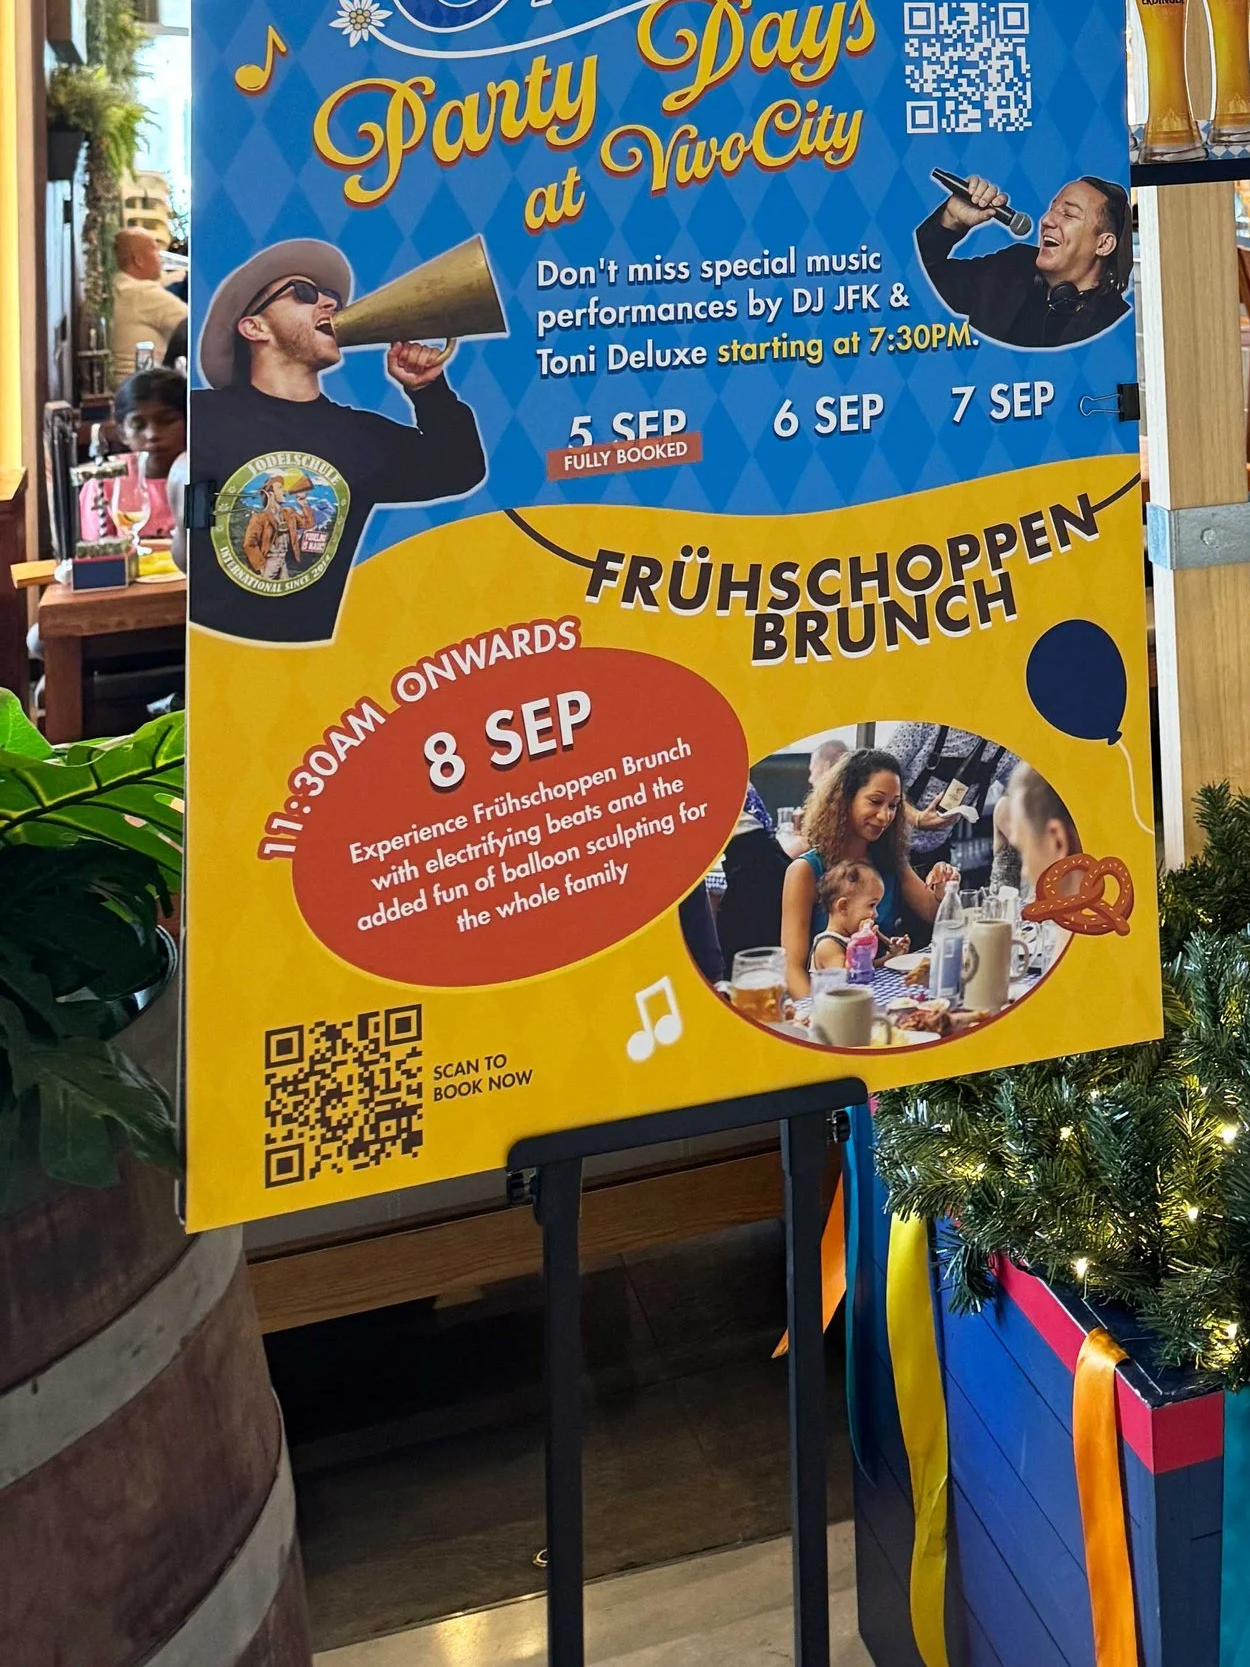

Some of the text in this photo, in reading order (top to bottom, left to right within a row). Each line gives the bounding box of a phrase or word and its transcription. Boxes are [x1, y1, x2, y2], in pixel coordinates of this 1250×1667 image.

[313, 53, 599, 207] Party
[524, 98, 863, 231] at VivoCity
[537, 245, 881, 287] Don't miss special music
[537, 283, 910, 337] performances by DJ JFK &
[536, 322, 979, 375] Toni Deluxe starting at 7:30PM.
[568, 407, 687, 450] 5 SEP
[773, 393, 884, 438] 6 SEP
[951, 381, 1055, 423] 7 SEP
[564, 441, 688, 471] FULLY BOOKED
[220, 545, 283, 593] INTERNATIONAL
[285, 577, 309, 592] SINCE
[585, 492, 1099, 617] FRÜHSCHOPPEN
[751, 572, 1017, 666] BRUNCH
[263, 620, 577, 855] 11:30AM ONWARDS
[424, 690, 592, 788] 8 SEP
[349, 737, 692, 864] Experience Frühschoppen Brunch
[371, 776, 685, 891] with electrifying beats and the
[357, 801, 709, 932] added fun of balloon sculpting for
[456, 859, 630, 933] the whole family
[433, 1054, 507, 1081] SCAN TO
[433, 1069, 533, 1102] BOOK NOW
